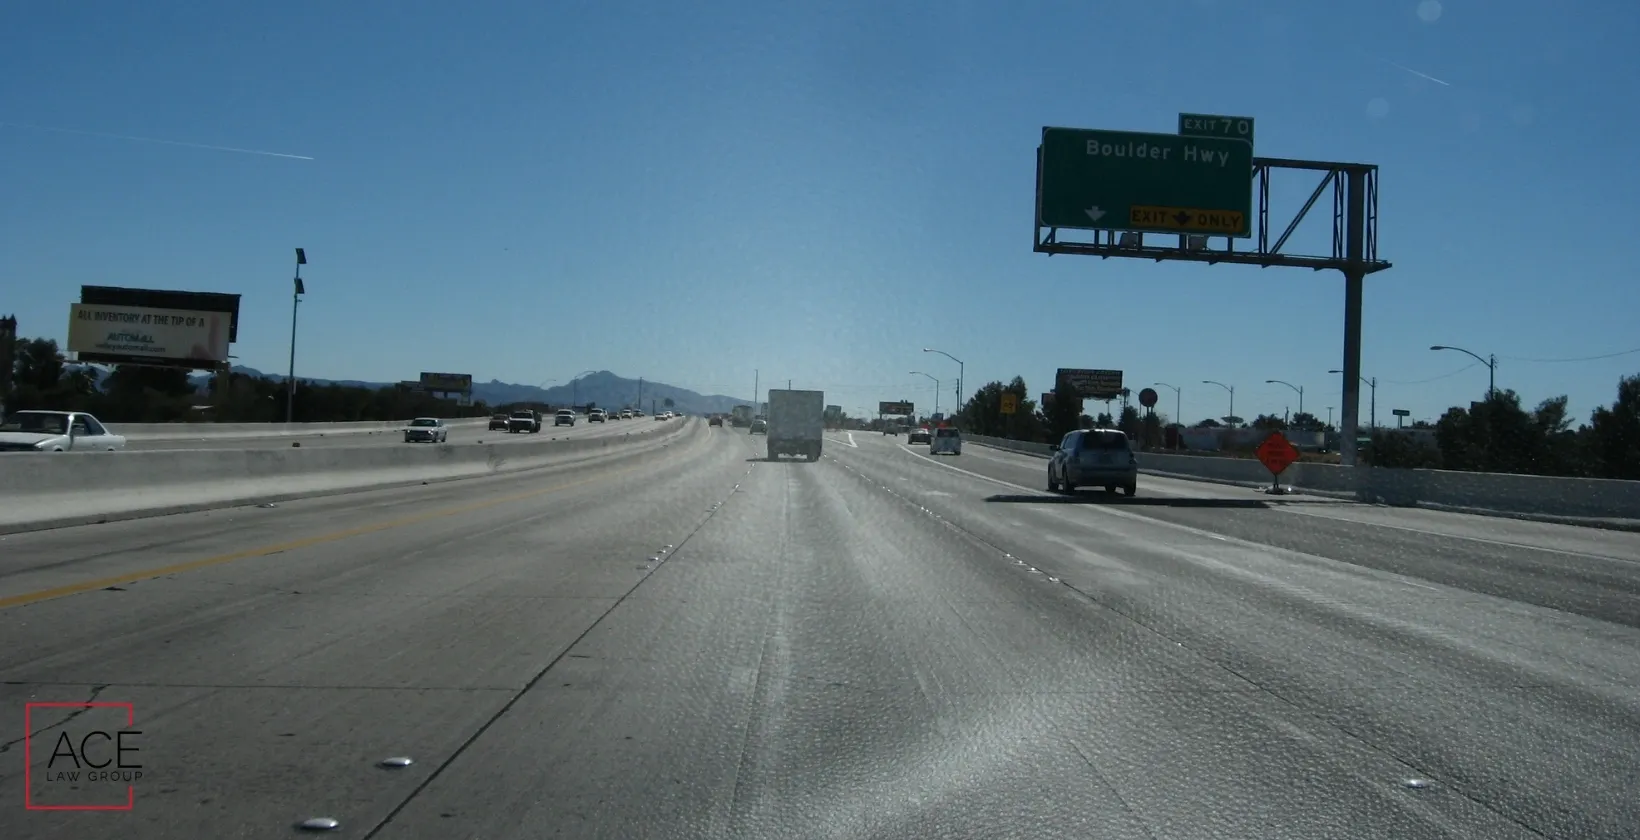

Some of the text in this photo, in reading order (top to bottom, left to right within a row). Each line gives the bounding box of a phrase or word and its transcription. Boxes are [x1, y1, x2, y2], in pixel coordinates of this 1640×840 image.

[1184, 118, 1249, 135] EXIT 70
[1086, 139, 1229, 167] Boulder Hwy
[1132, 210, 1241, 227] EXIT ONLY
[78, 310, 205, 328] ALL INVENTORY AT THE TIP OF A
